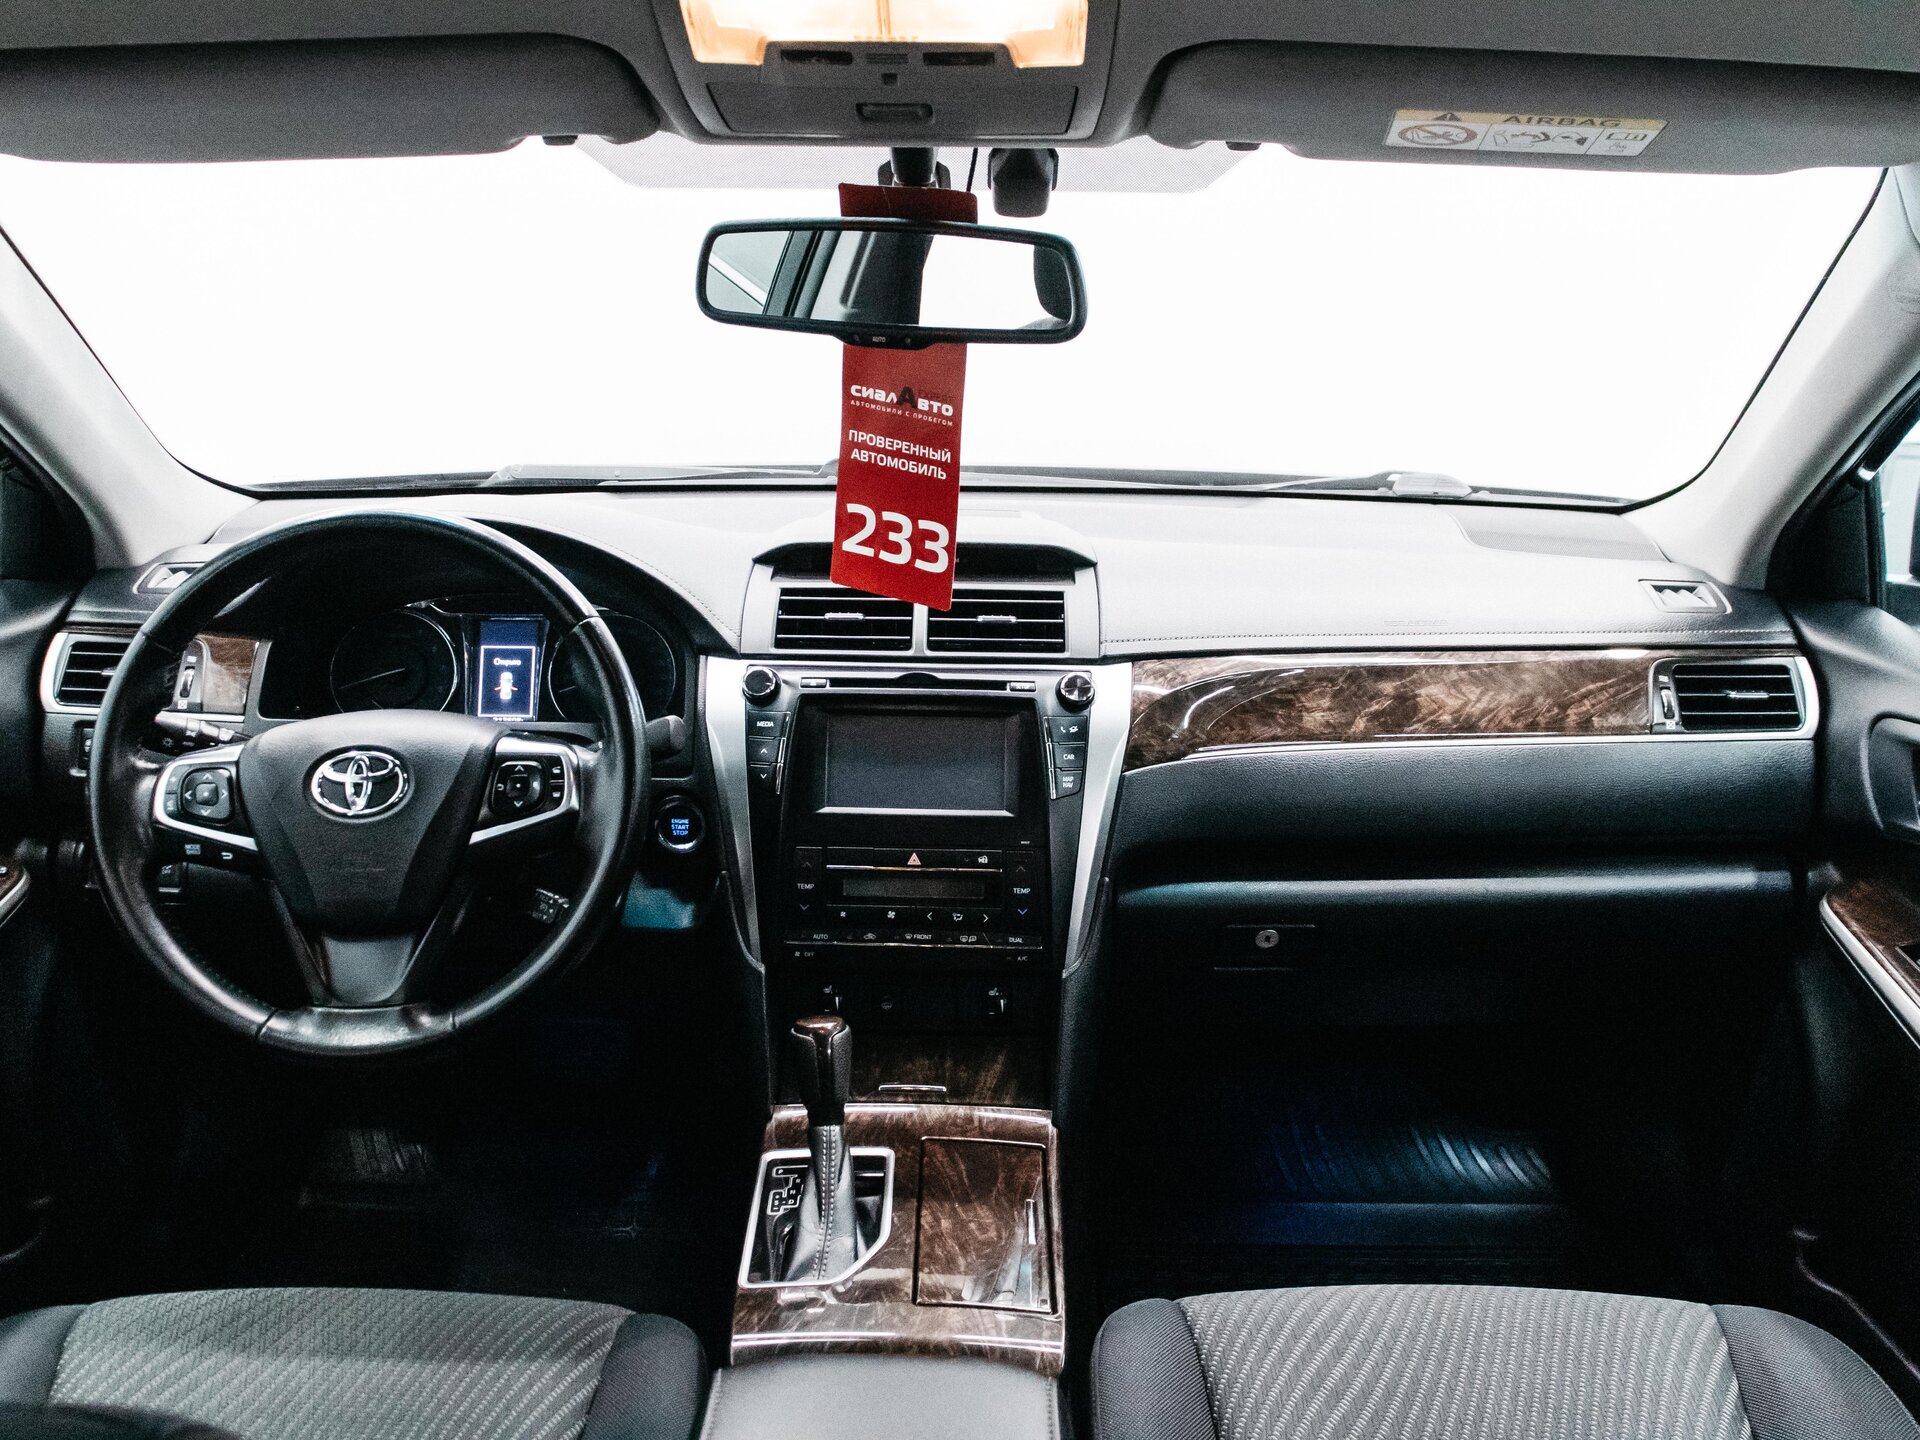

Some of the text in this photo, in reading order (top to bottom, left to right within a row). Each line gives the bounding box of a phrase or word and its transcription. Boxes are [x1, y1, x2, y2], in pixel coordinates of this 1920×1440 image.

[1502, 115, 1622, 128] AIRBAG
[850, 399, 903, 416] АВТОМОБИЛИ
[912, 413, 953, 427] ПРОБЕГОМ
[848, 429, 952, 463] ПРОВЕРЕННЫЙ
[850, 448, 947, 480] АВТОМОБИЛЬ
[841, 503, 950, 574] 233
